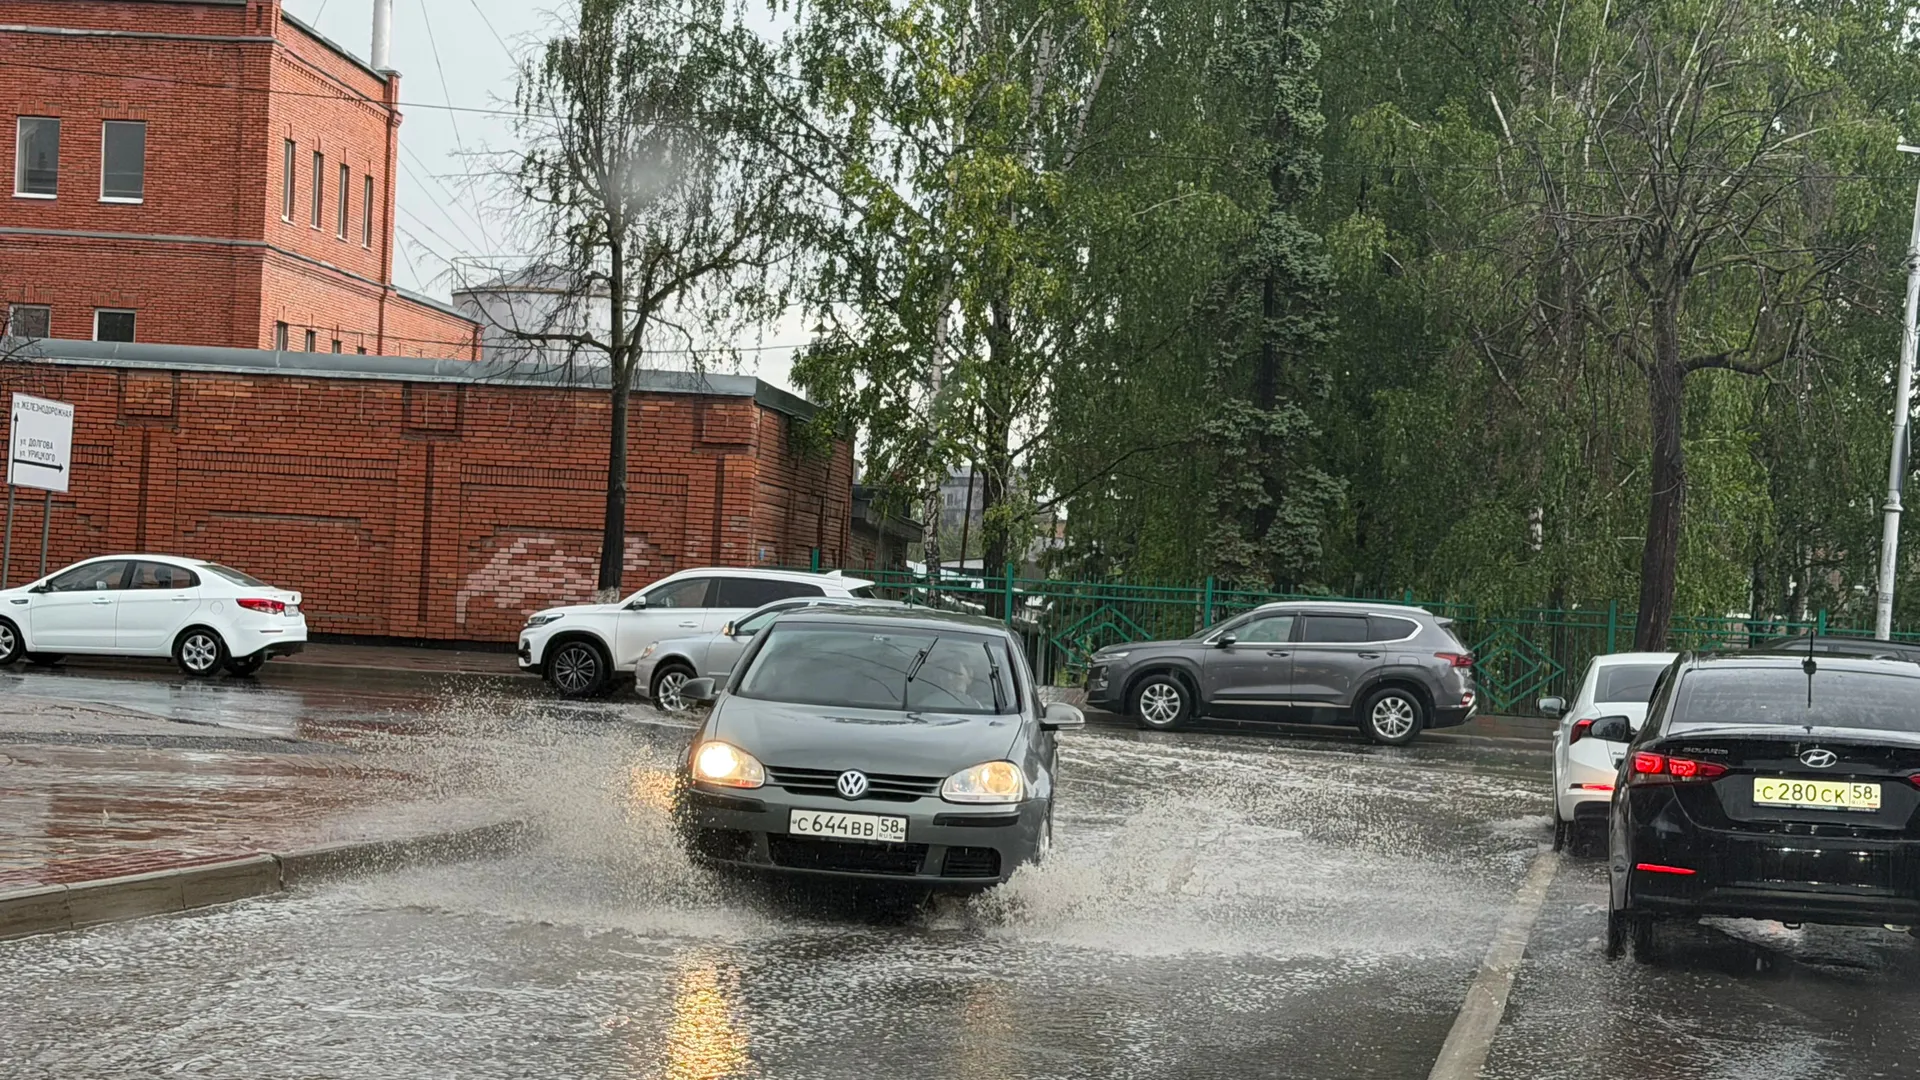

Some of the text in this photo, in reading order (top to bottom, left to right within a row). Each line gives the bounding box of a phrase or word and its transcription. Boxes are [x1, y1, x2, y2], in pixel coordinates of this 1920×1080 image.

[28, 438, 54, 449] ДОЛГОВА
[28, 450, 56, 462] УРИЦКОГО
[1853, 785, 1873, 799] 58
[797, 814, 900, 837] С644ВВ 58
